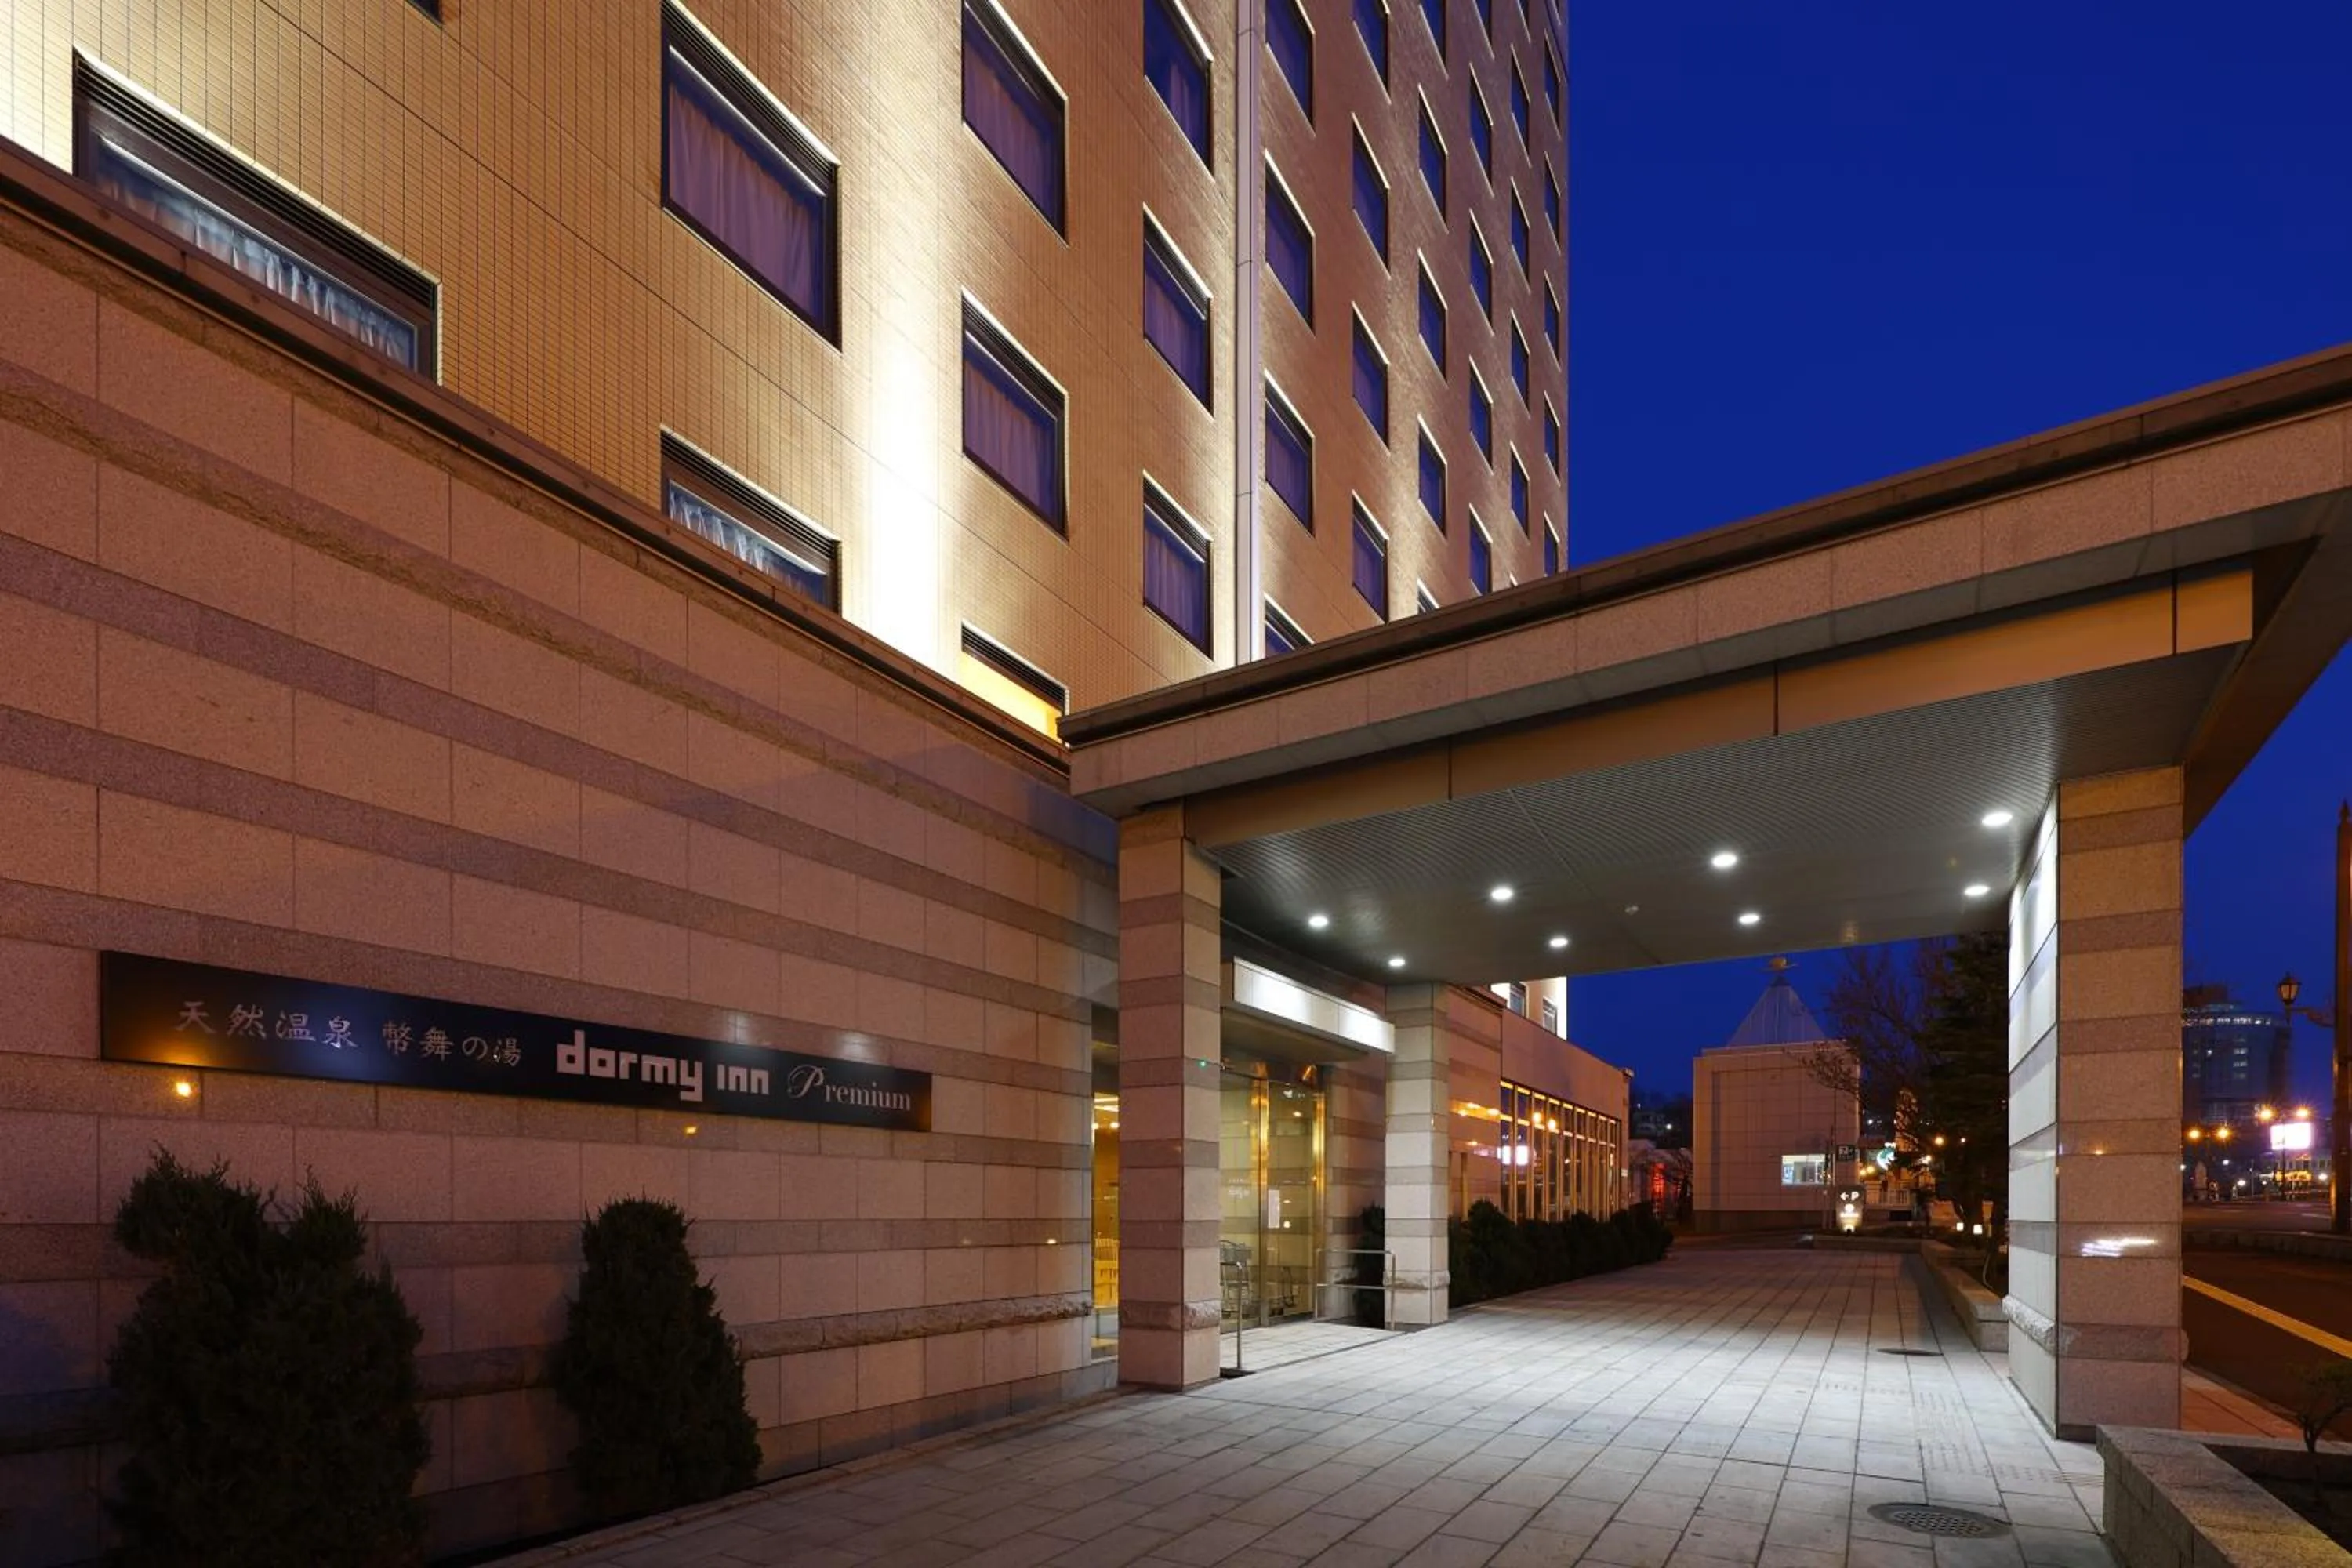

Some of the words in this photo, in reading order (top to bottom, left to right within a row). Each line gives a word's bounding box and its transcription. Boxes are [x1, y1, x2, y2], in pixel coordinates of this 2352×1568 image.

[176, 1000, 359, 1049] 天然温泉
[381, 1020, 522, 1067] 幣舞の湯
[557, 1029, 703, 1102] dormy
[717, 1064, 769, 1094] inn
[787, 1064, 911, 1111] Premium
[1851, 1191, 1860, 1200] P
